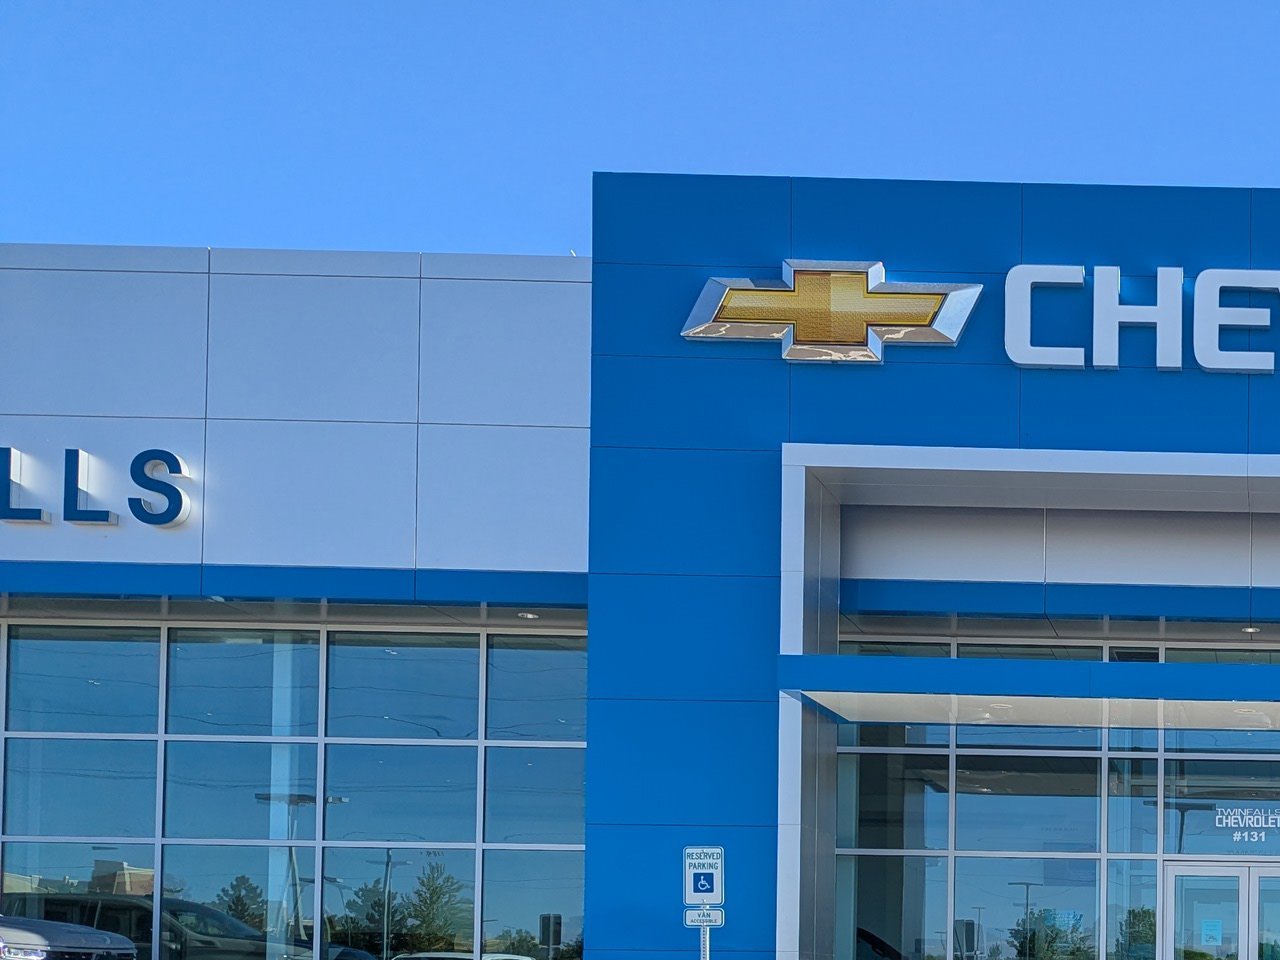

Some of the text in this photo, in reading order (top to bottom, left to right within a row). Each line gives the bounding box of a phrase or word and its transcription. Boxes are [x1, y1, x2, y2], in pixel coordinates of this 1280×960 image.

[1232, 831, 1266, 842] #131
[686, 852, 721, 860] RESERVED
[688, 862, 719, 870] PARKING
